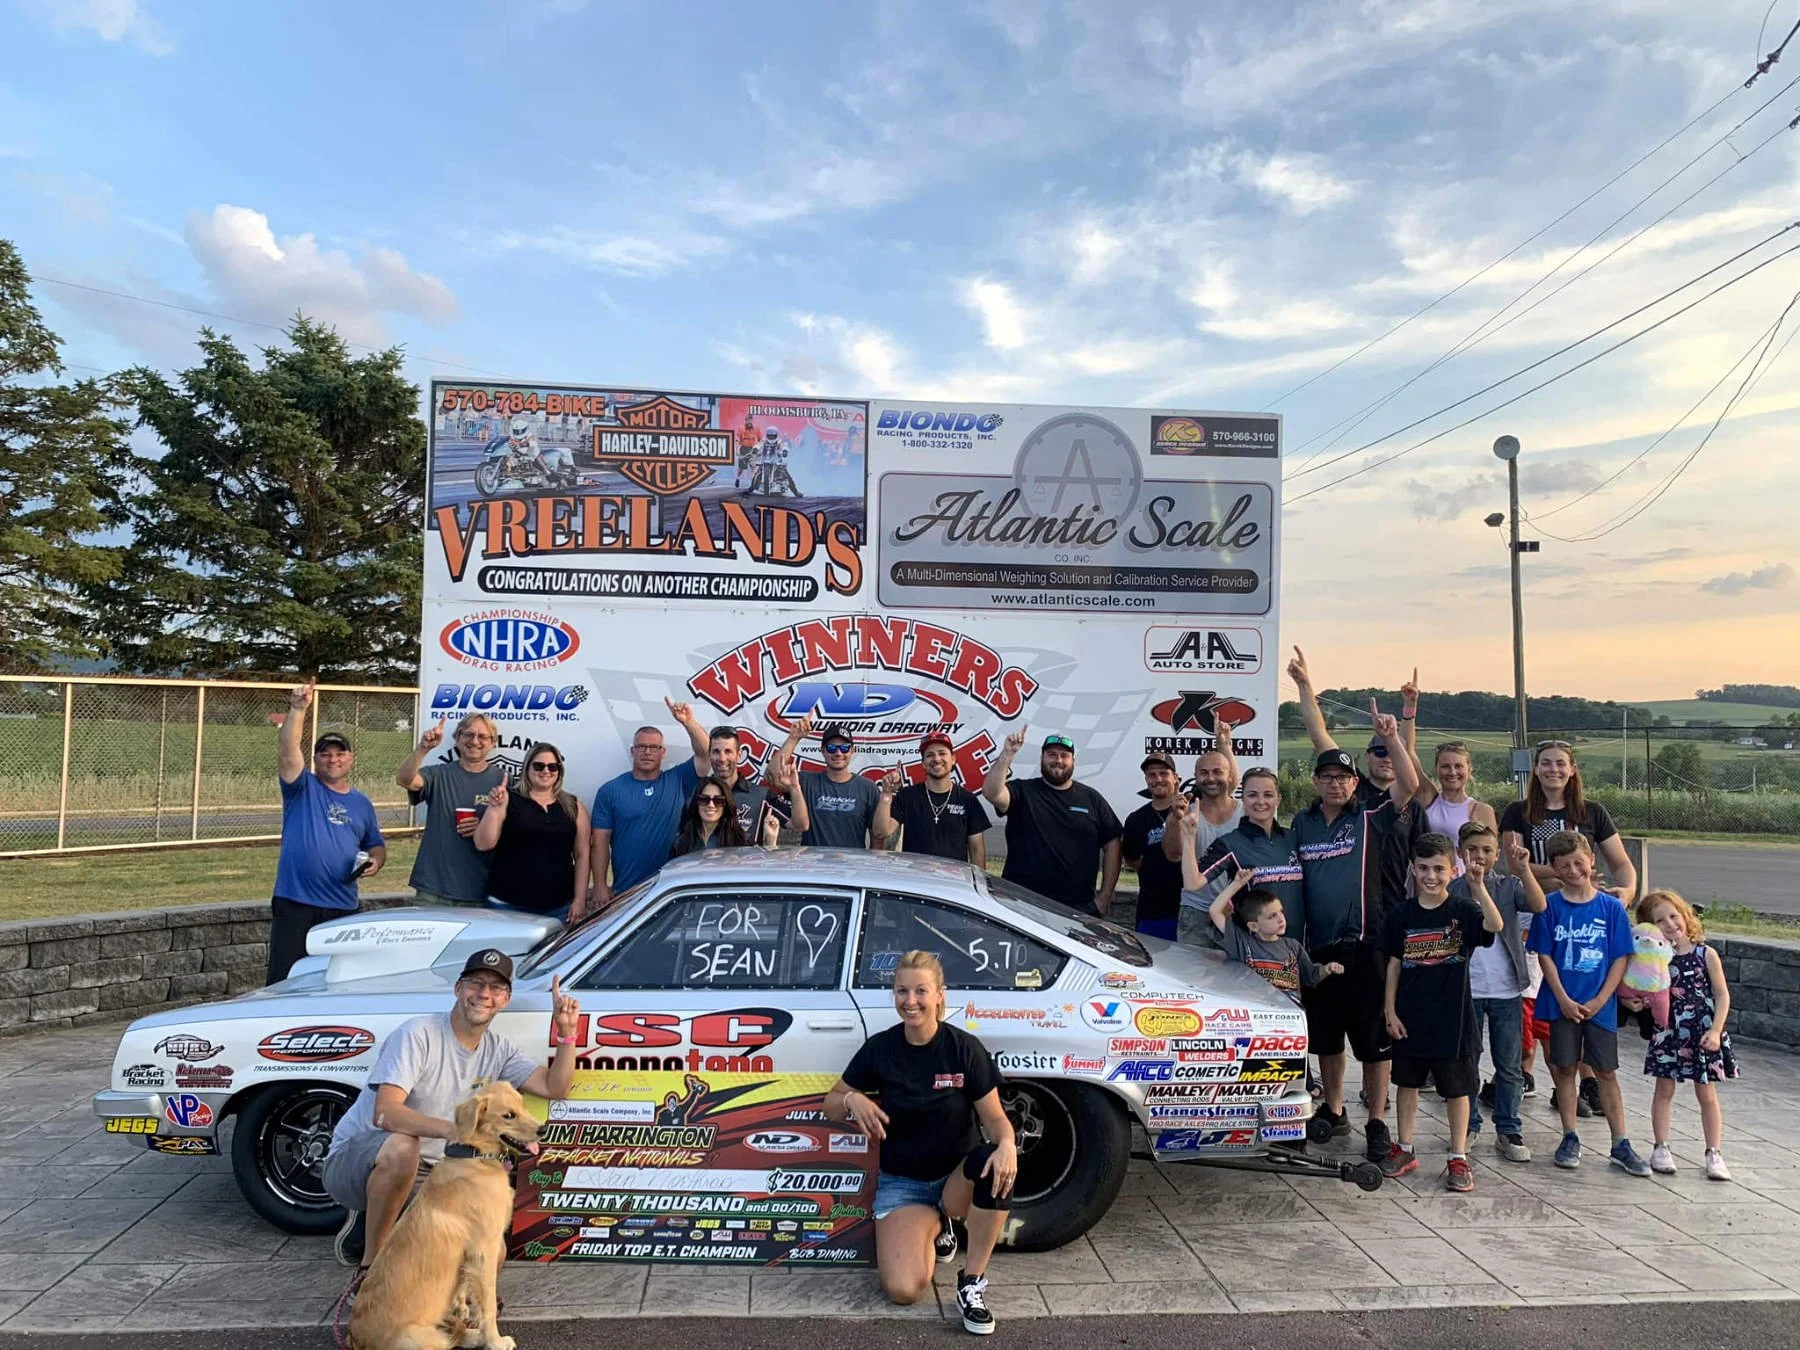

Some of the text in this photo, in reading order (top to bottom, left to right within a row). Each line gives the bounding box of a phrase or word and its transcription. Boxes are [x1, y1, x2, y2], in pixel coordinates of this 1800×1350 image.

[443, 389, 606, 417] 570-784-BIKE
[630, 404, 697, 428] MOTOR
[877, 410, 998, 432] BIONDO
[902, 440, 973, 449] 1-800-332-1320
[918, 432, 972, 441] PRODUCTS,
[1212, 431, 1275, 442] 570-966-3100
[602, 432, 727, 458] HARLEY-DAVIDSON
[631, 462, 699, 489] CYCLES
[895, 488, 1261, 549] Atlantic Scale
[434, 495, 862, 597] VREELAND'S
[485, 570, 812, 600] CONGRATULATIONS ON ANOTHER CHAMPIONSHIP
[896, 568, 1253, 588] A Multi-Dimensional Weighing Solution and Calibration Service Provider
[992, 593, 1155, 607] www.atlanticscale.com
[463, 609, 560, 626] CHAMPIONSHIP
[463, 620, 561, 660] NHRA
[462, 656, 558, 672] DRAG RACING
[687, 614, 1039, 720] WINNERS
[1153, 660, 1245, 670] AUTO STORE
[431, 684, 583, 710] BIONDO
[779, 682, 916, 719] ND
[431, 711, 467, 720] RACIN
[557, 713, 580, 721] INC.
[878, 722, 965, 735] DRAGWAY
[1146, 738, 1263, 749] KOREK DEGNS
[696, 902, 761, 940] FOR
[1555, 923, 1607, 943] Brooklyn
[690, 942, 775, 982] SEAN
[1120, 991, 1204, 1000] COMPUTECH
[269, 1033, 368, 1048] Select
[1110, 1039, 1167, 1052] SIMPSON
[1172, 1040, 1224, 1050] LINCOLN
[1247, 1036, 1308, 1057] pace
[1064, 1053, 1106, 1070] SUMMIT
[1184, 1052, 1229, 1061] WELDERS
[122, 1069, 165, 1078] Bracket
[1106, 1060, 1175, 1081] AFCO
[1175, 1063, 1239, 1078] COMETIC
[1239, 1071, 1303, 1082] IMPACT
[127, 1078, 164, 1087] Racing
[1151, 1086, 1205, 1097] MANLEY
[1217, 1085, 1273, 1097] MANLEY
[167, 1094, 199, 1127] VP
[568, 1106, 591, 1114] Atlantic
[611, 1108, 640, 1116] Company,
[785, 1111, 816, 1120] JULY
[1151, 1105, 1207, 1118] Strange
[1273, 1106, 1298, 1117] NHRA
[106, 1118, 159, 1134] JEGS
[540, 1124, 717, 1148] JIM HARRINGTON
[752, 1134, 800, 1144] ND
[1200, 1130, 1255, 1145] JE
[538, 1149, 706, 1168] BRACKET NATIONALS
[528, 1170, 551, 1188] Pay
[551, 1171, 563, 1184] to
[768, 1168, 861, 1194] $20,000.00
[541, 1193, 818, 1214] TWENTY THOUSAND and 00/100
[570, 1242, 757, 1259] FRIDAY TOP E.T. CHAMPION
[789, 1248, 857, 1262] BOB DIMINO
